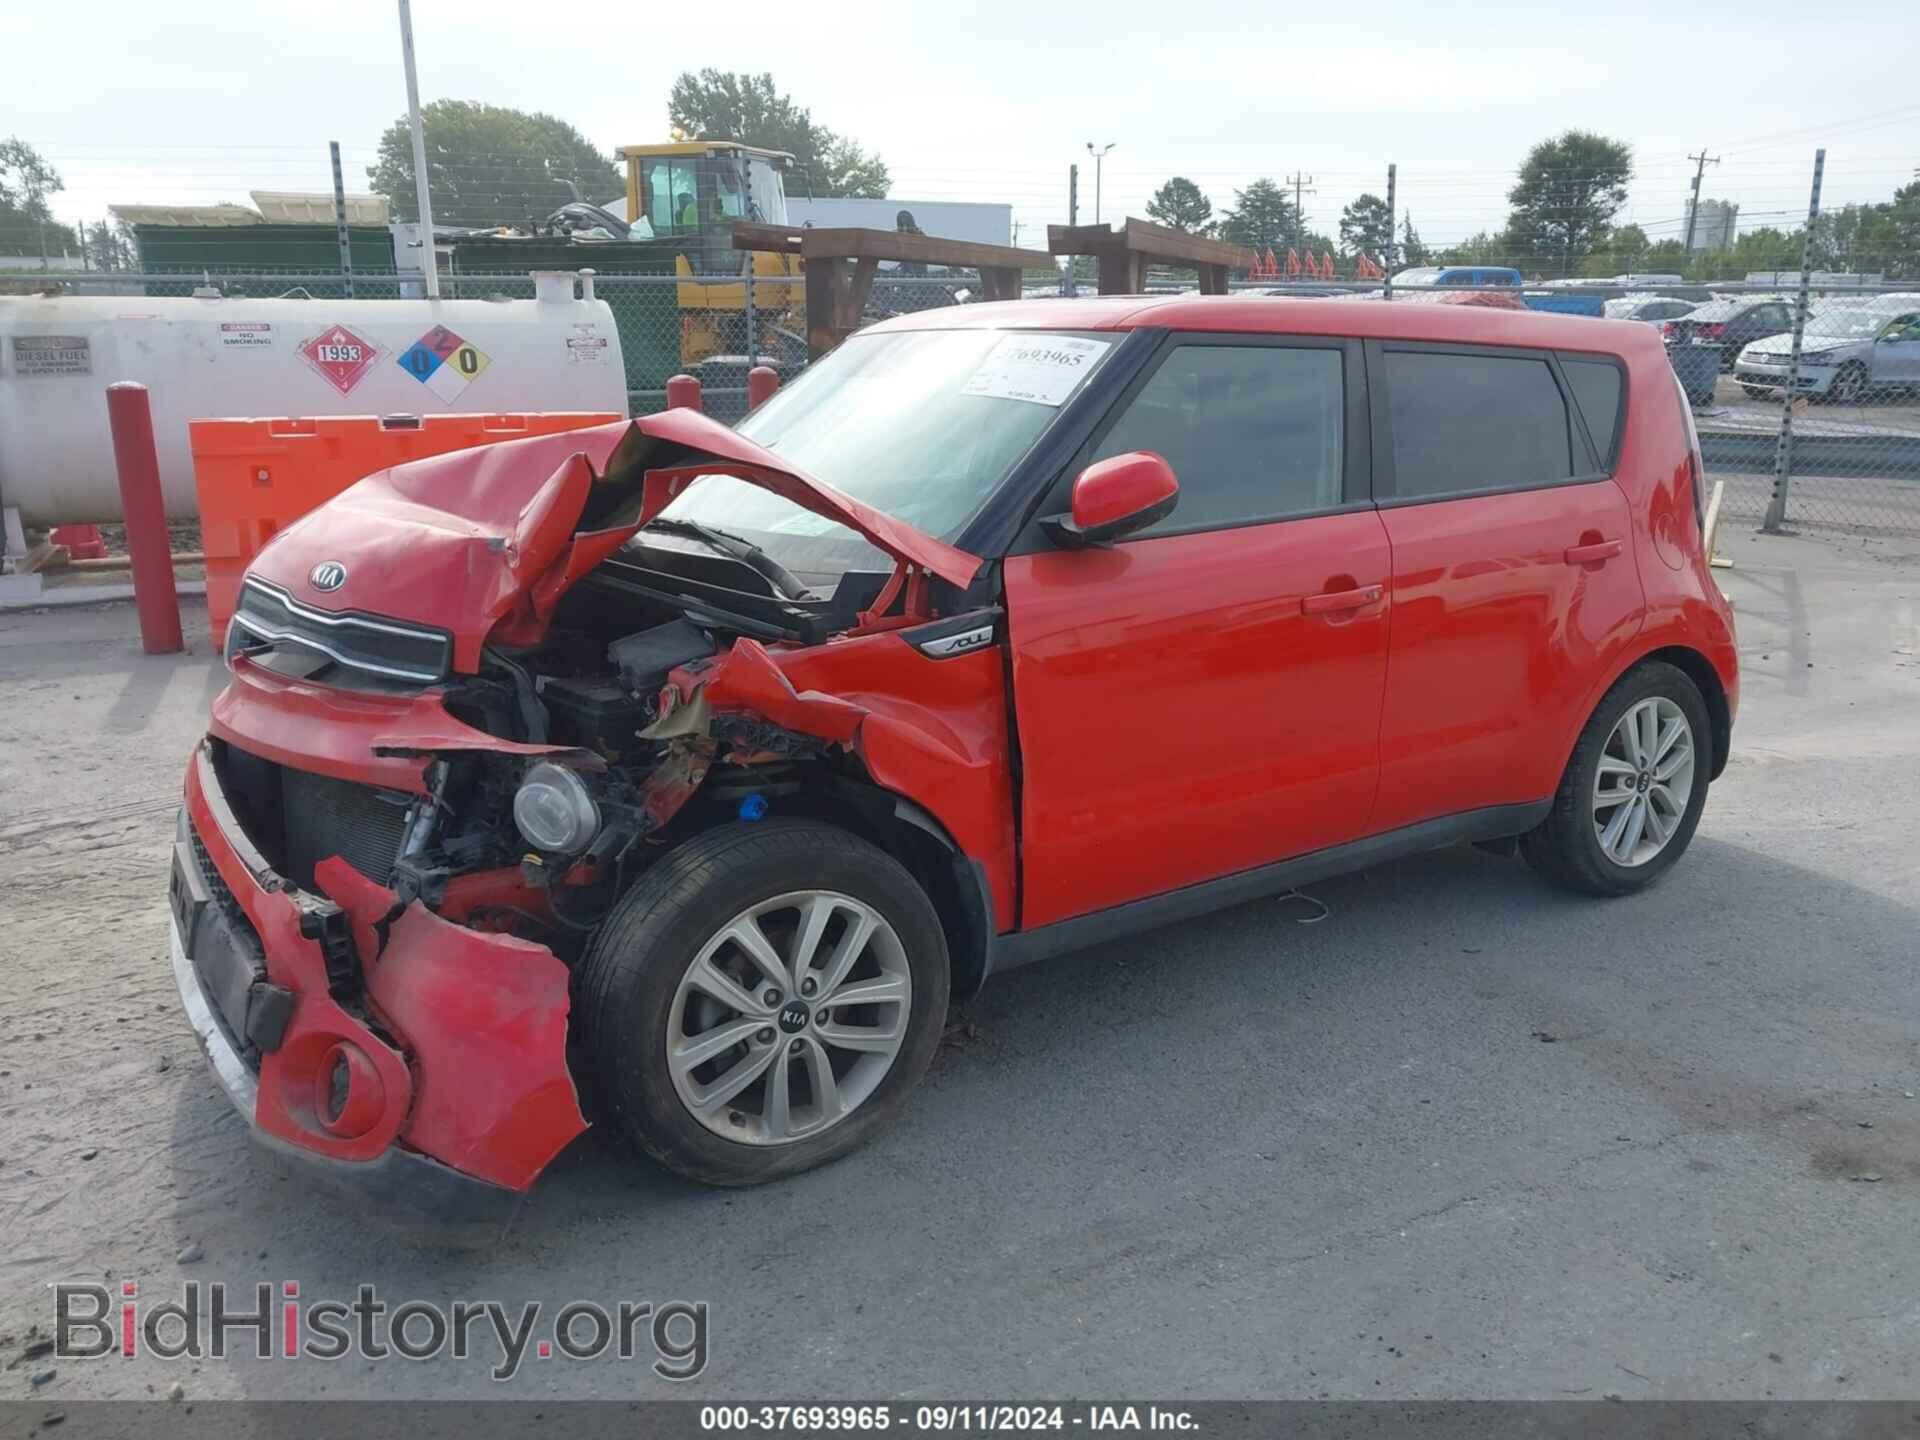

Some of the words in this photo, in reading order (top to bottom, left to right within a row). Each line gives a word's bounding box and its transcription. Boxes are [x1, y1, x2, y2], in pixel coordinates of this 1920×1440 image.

[432, 328, 452, 352] 2
[15, 351, 57, 361] DIESEL
[59, 351, 88, 361] FUEL
[320, 345, 361, 361] 1993
[411, 348, 431, 374] 0
[459, 348, 478, 374] 0
[312, 566, 339, 587] KIA
[782, 1010, 806, 1025] KIA
